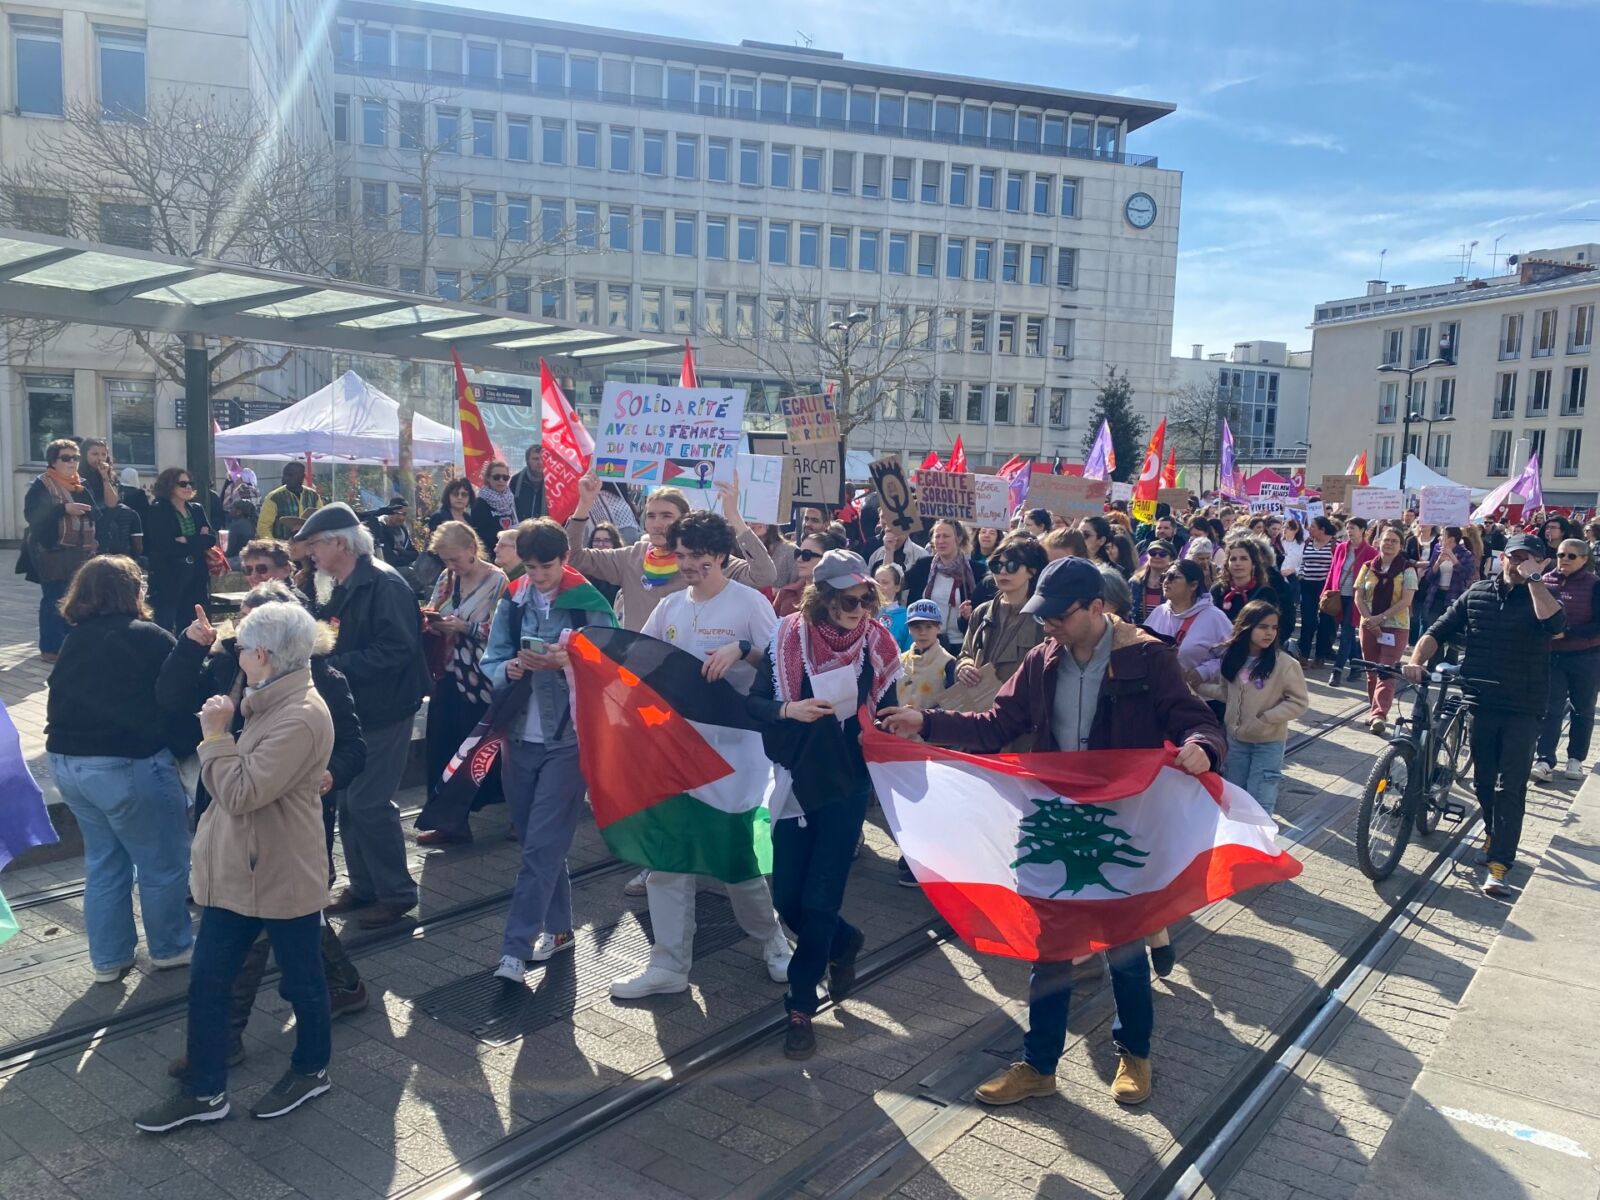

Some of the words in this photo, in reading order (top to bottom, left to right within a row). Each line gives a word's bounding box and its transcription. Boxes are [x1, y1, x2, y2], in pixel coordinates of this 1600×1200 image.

[474, 388, 481, 398] B
[605, 422, 638, 436] AVEC
[645, 424, 665, 437] LES
[669, 424, 725, 440] FEMMES
[607, 442, 624, 454] DU
[629, 441, 674, 456] MONDE
[751, 458, 778, 483] LE
[917, 471, 968, 489] EGALITE
